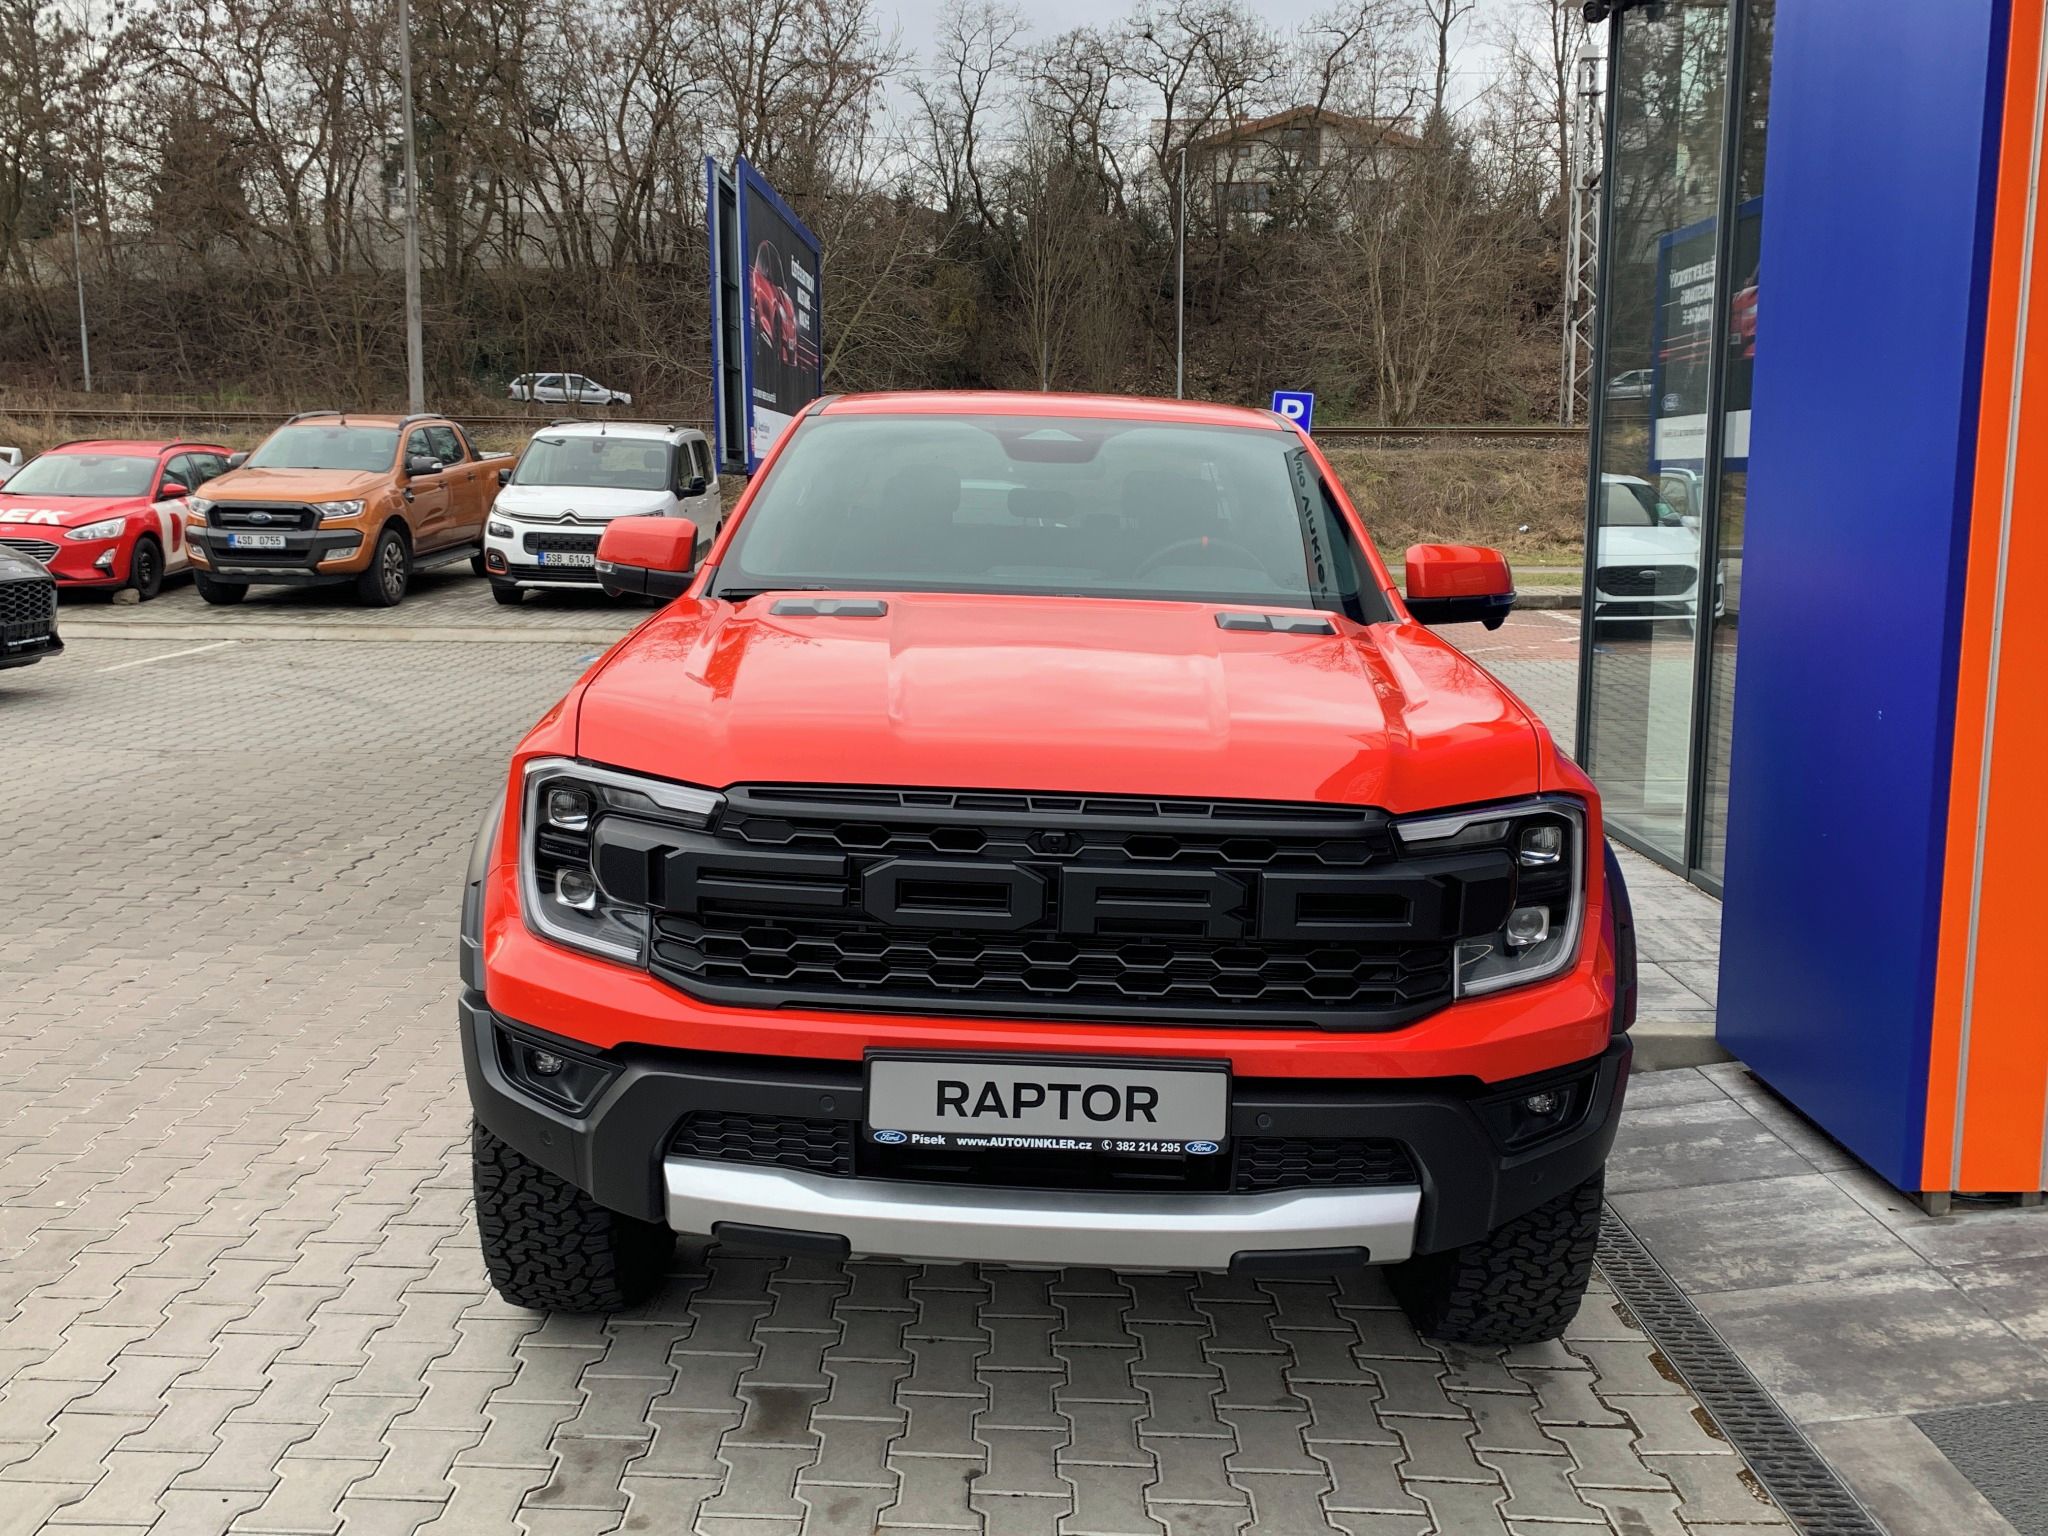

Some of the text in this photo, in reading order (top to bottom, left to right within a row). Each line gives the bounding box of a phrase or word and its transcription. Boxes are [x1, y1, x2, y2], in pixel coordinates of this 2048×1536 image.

[1281, 398, 1305, 420] P
[0, 508, 72, 525] EK
[237, 535, 281, 545] 4SD 0755
[546, 553, 591, 564] 5SB 6143
[663, 848, 1448, 942] FORD
[935, 1079, 1160, 1123] RAPTOR
[878, 1131, 1215, 1153] Ford Písek www.AUTOVINKLER.cz 382 214 295 Ford
